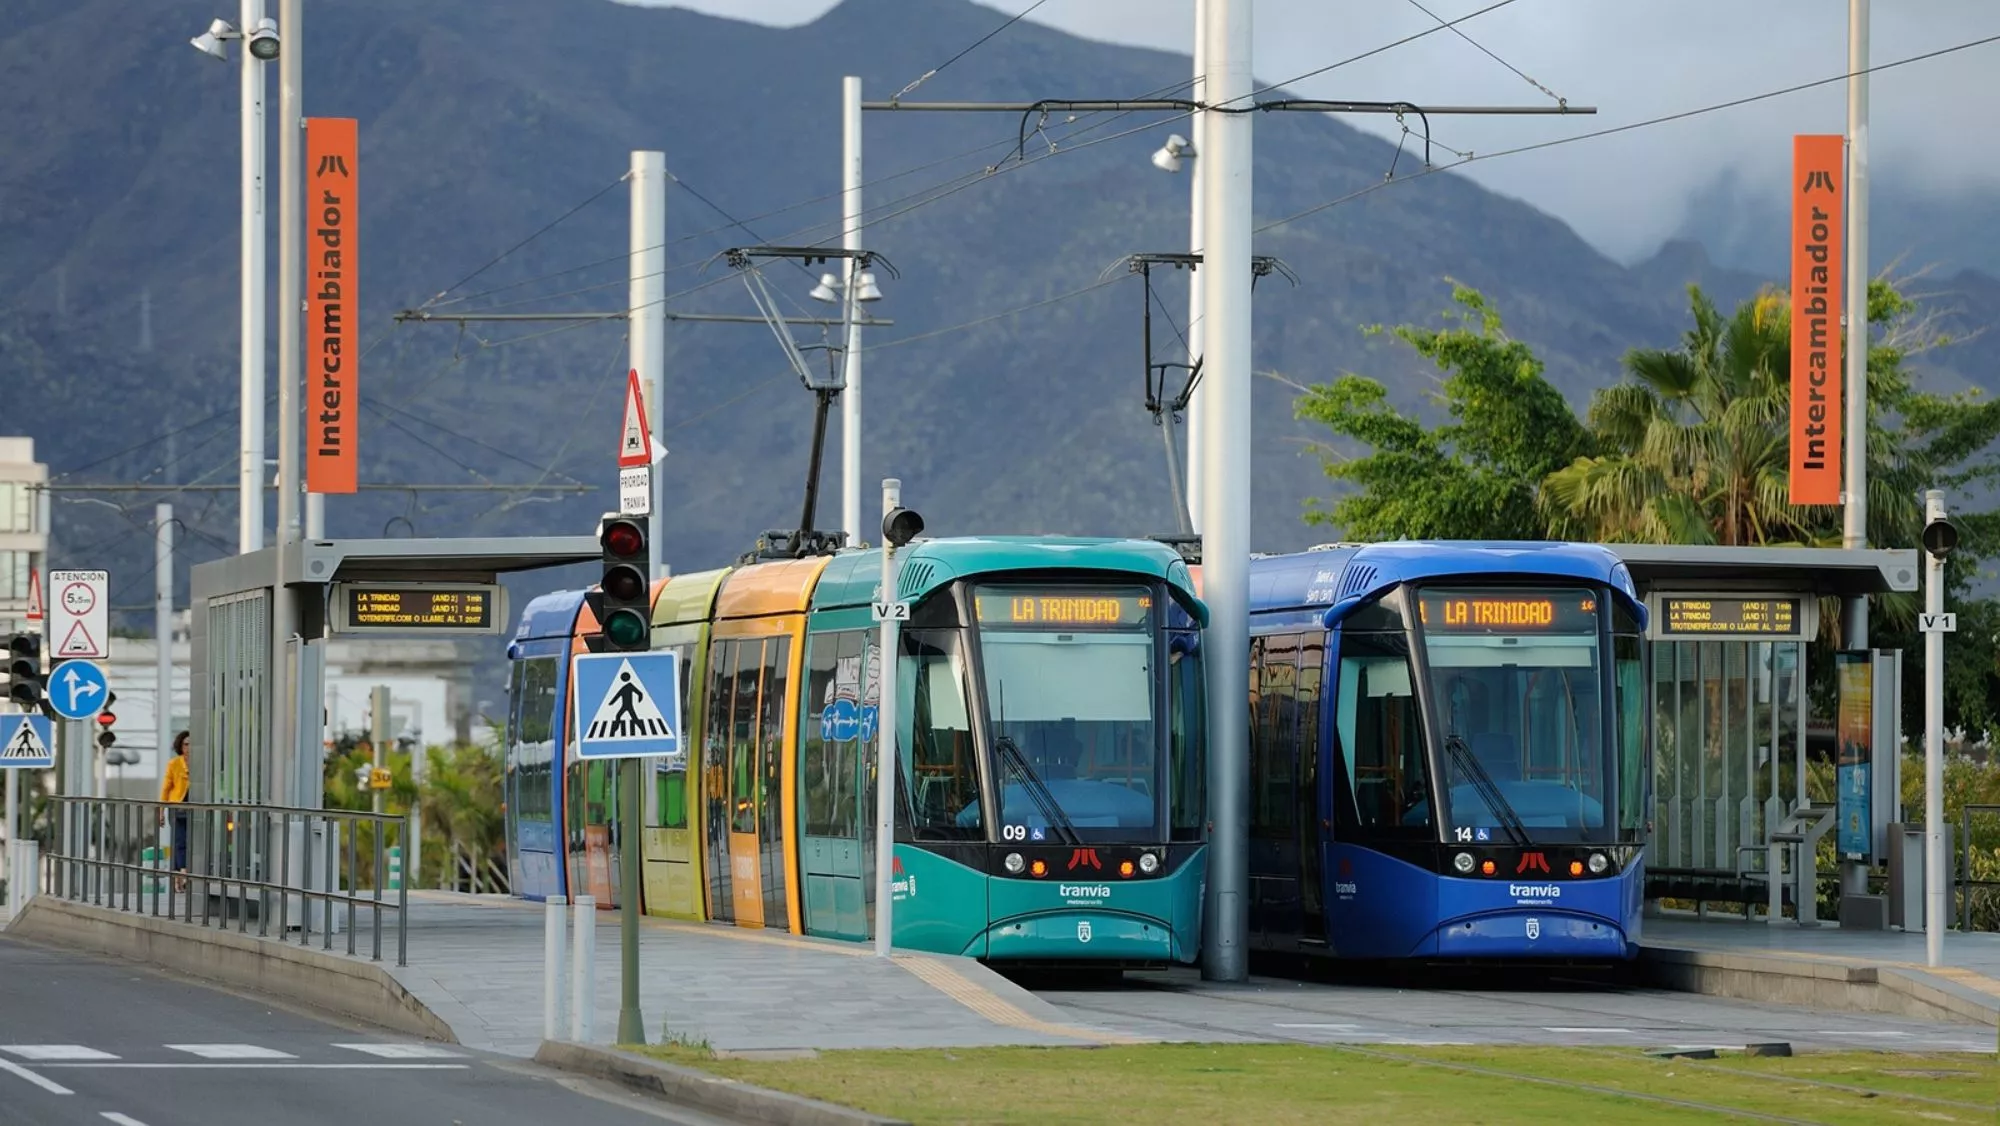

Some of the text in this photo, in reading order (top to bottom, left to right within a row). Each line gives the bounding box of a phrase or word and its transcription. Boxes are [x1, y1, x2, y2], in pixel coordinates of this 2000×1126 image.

[317, 189, 341, 457] Intercambiador
[1803, 205, 1828, 470] Intercambiador
[621, 473, 648, 488] PRIORIDAD
[357, 593, 368, 601] LA
[370, 593, 400, 602] TRINIDAD
[370, 604, 400, 612] TRINIDAD
[877, 604, 905, 618] V 2
[1013, 598, 1035, 621] LA
[1040, 598, 1120, 622] TRINIDAD
[1445, 600, 1468, 625] LA
[1472, 600, 1552, 625] TRINIDAD
[1670, 601, 1680, 610] LA
[1682, 601, 1711, 610] TRINIDAD
[1670, 612, 1680, 620] LA
[1682, 612, 1711, 620] TRINIDAD
[1924, 615, 1949, 628] V 1
[1737, 622, 1759, 631] LLAME
[1761, 622, 1771, 631] AL
[1003, 824, 1026, 841] 09
[1455, 826, 1472, 842] 14
